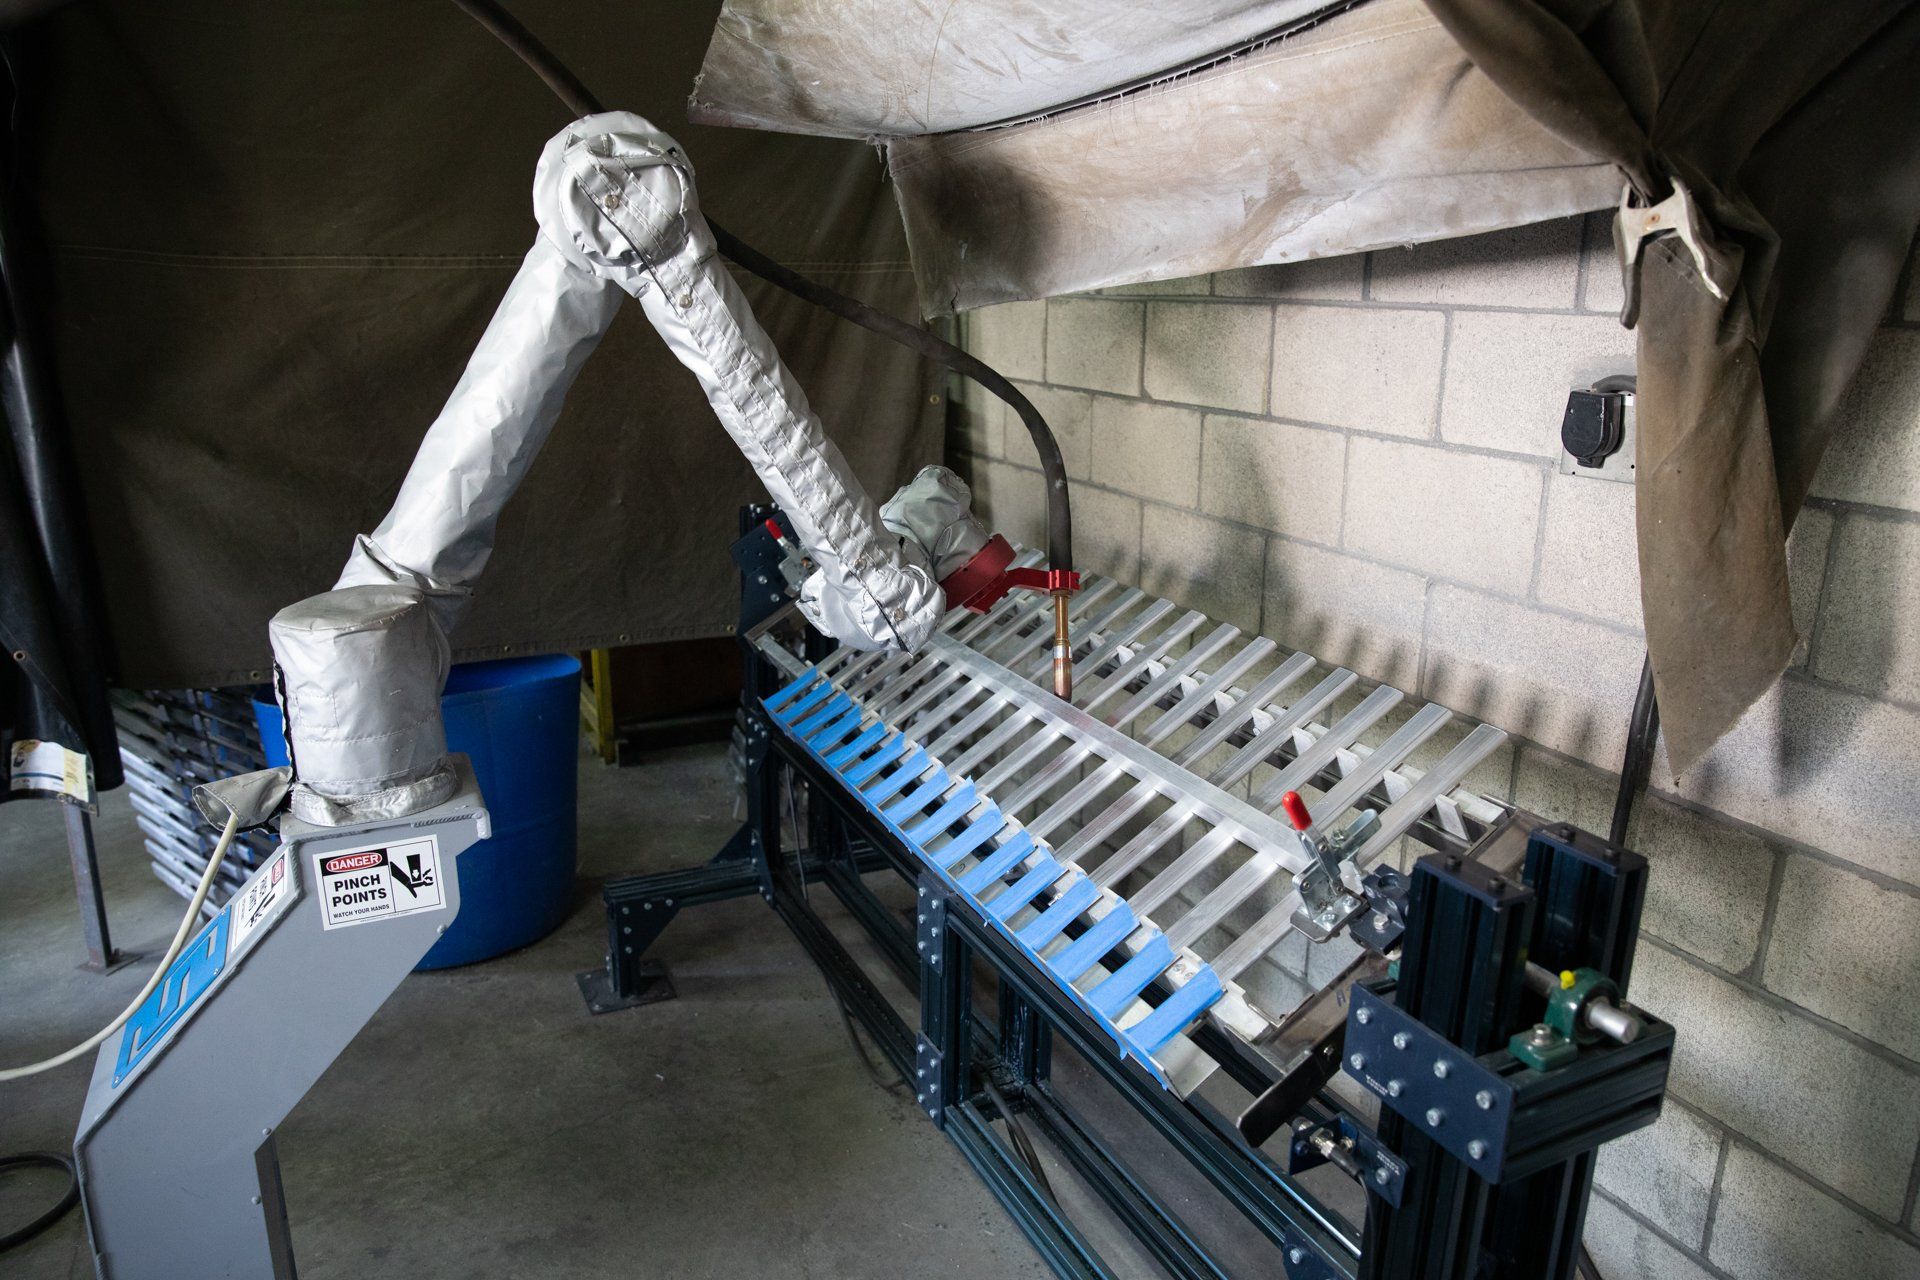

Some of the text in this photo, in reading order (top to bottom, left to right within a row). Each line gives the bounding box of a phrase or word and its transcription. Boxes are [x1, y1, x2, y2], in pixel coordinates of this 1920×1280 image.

[330, 854, 380, 871] DANGER
[334, 874, 381, 892] PINCH
[332, 888, 387, 907] POINTS
[333, 910, 354, 919] WATCH
[354, 907, 370, 915] YOUR
[370, 903, 390, 912] HANDS
